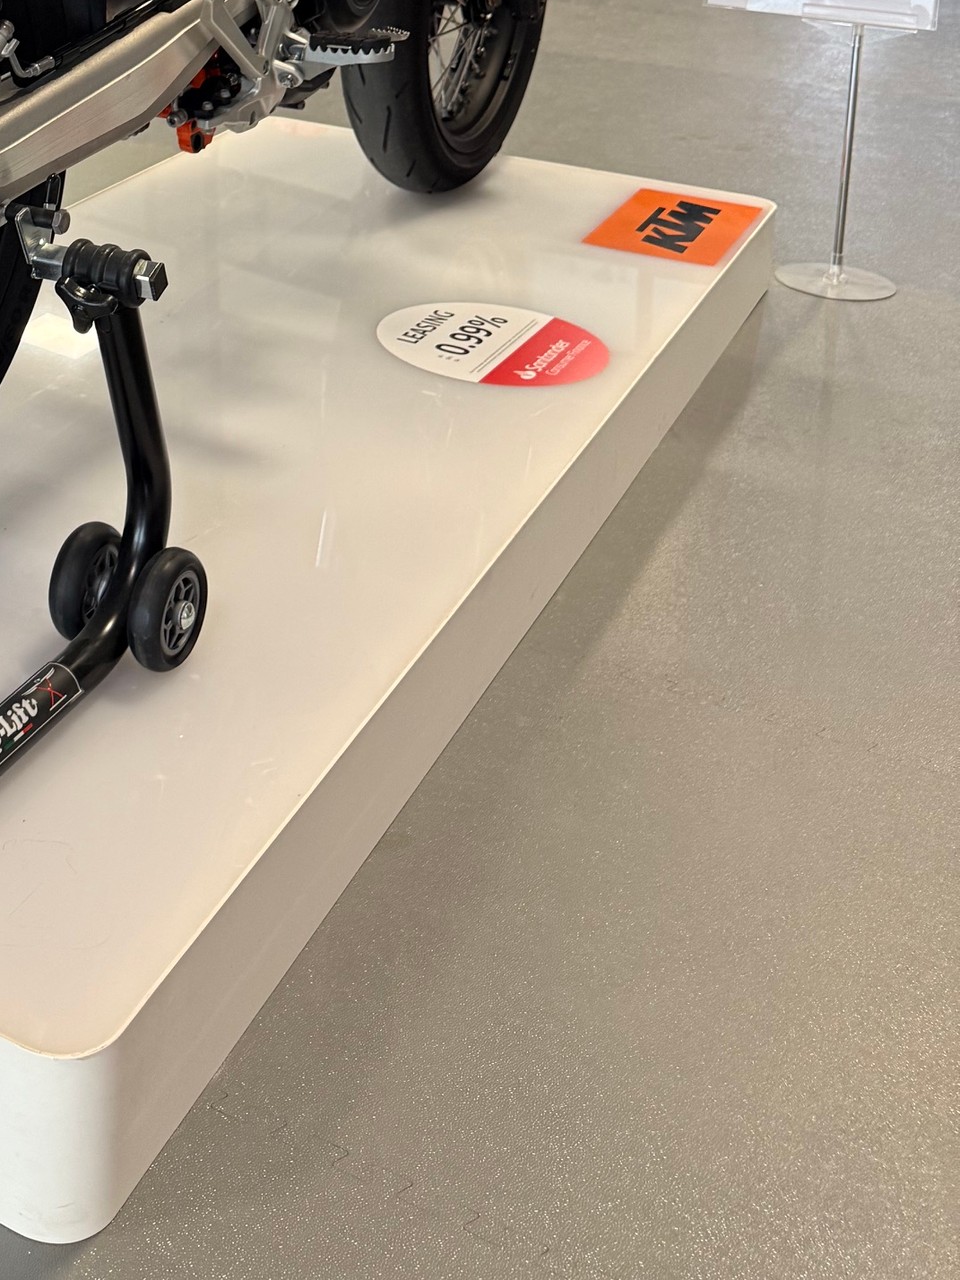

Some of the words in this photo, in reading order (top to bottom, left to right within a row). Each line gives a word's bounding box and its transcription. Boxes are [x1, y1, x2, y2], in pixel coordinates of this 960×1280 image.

[636, 200, 722, 254] KTM
[397, 309, 455, 344] LEASING
[435, 315, 508, 356] 0.99%
[525, 339, 570, 372] Santander
